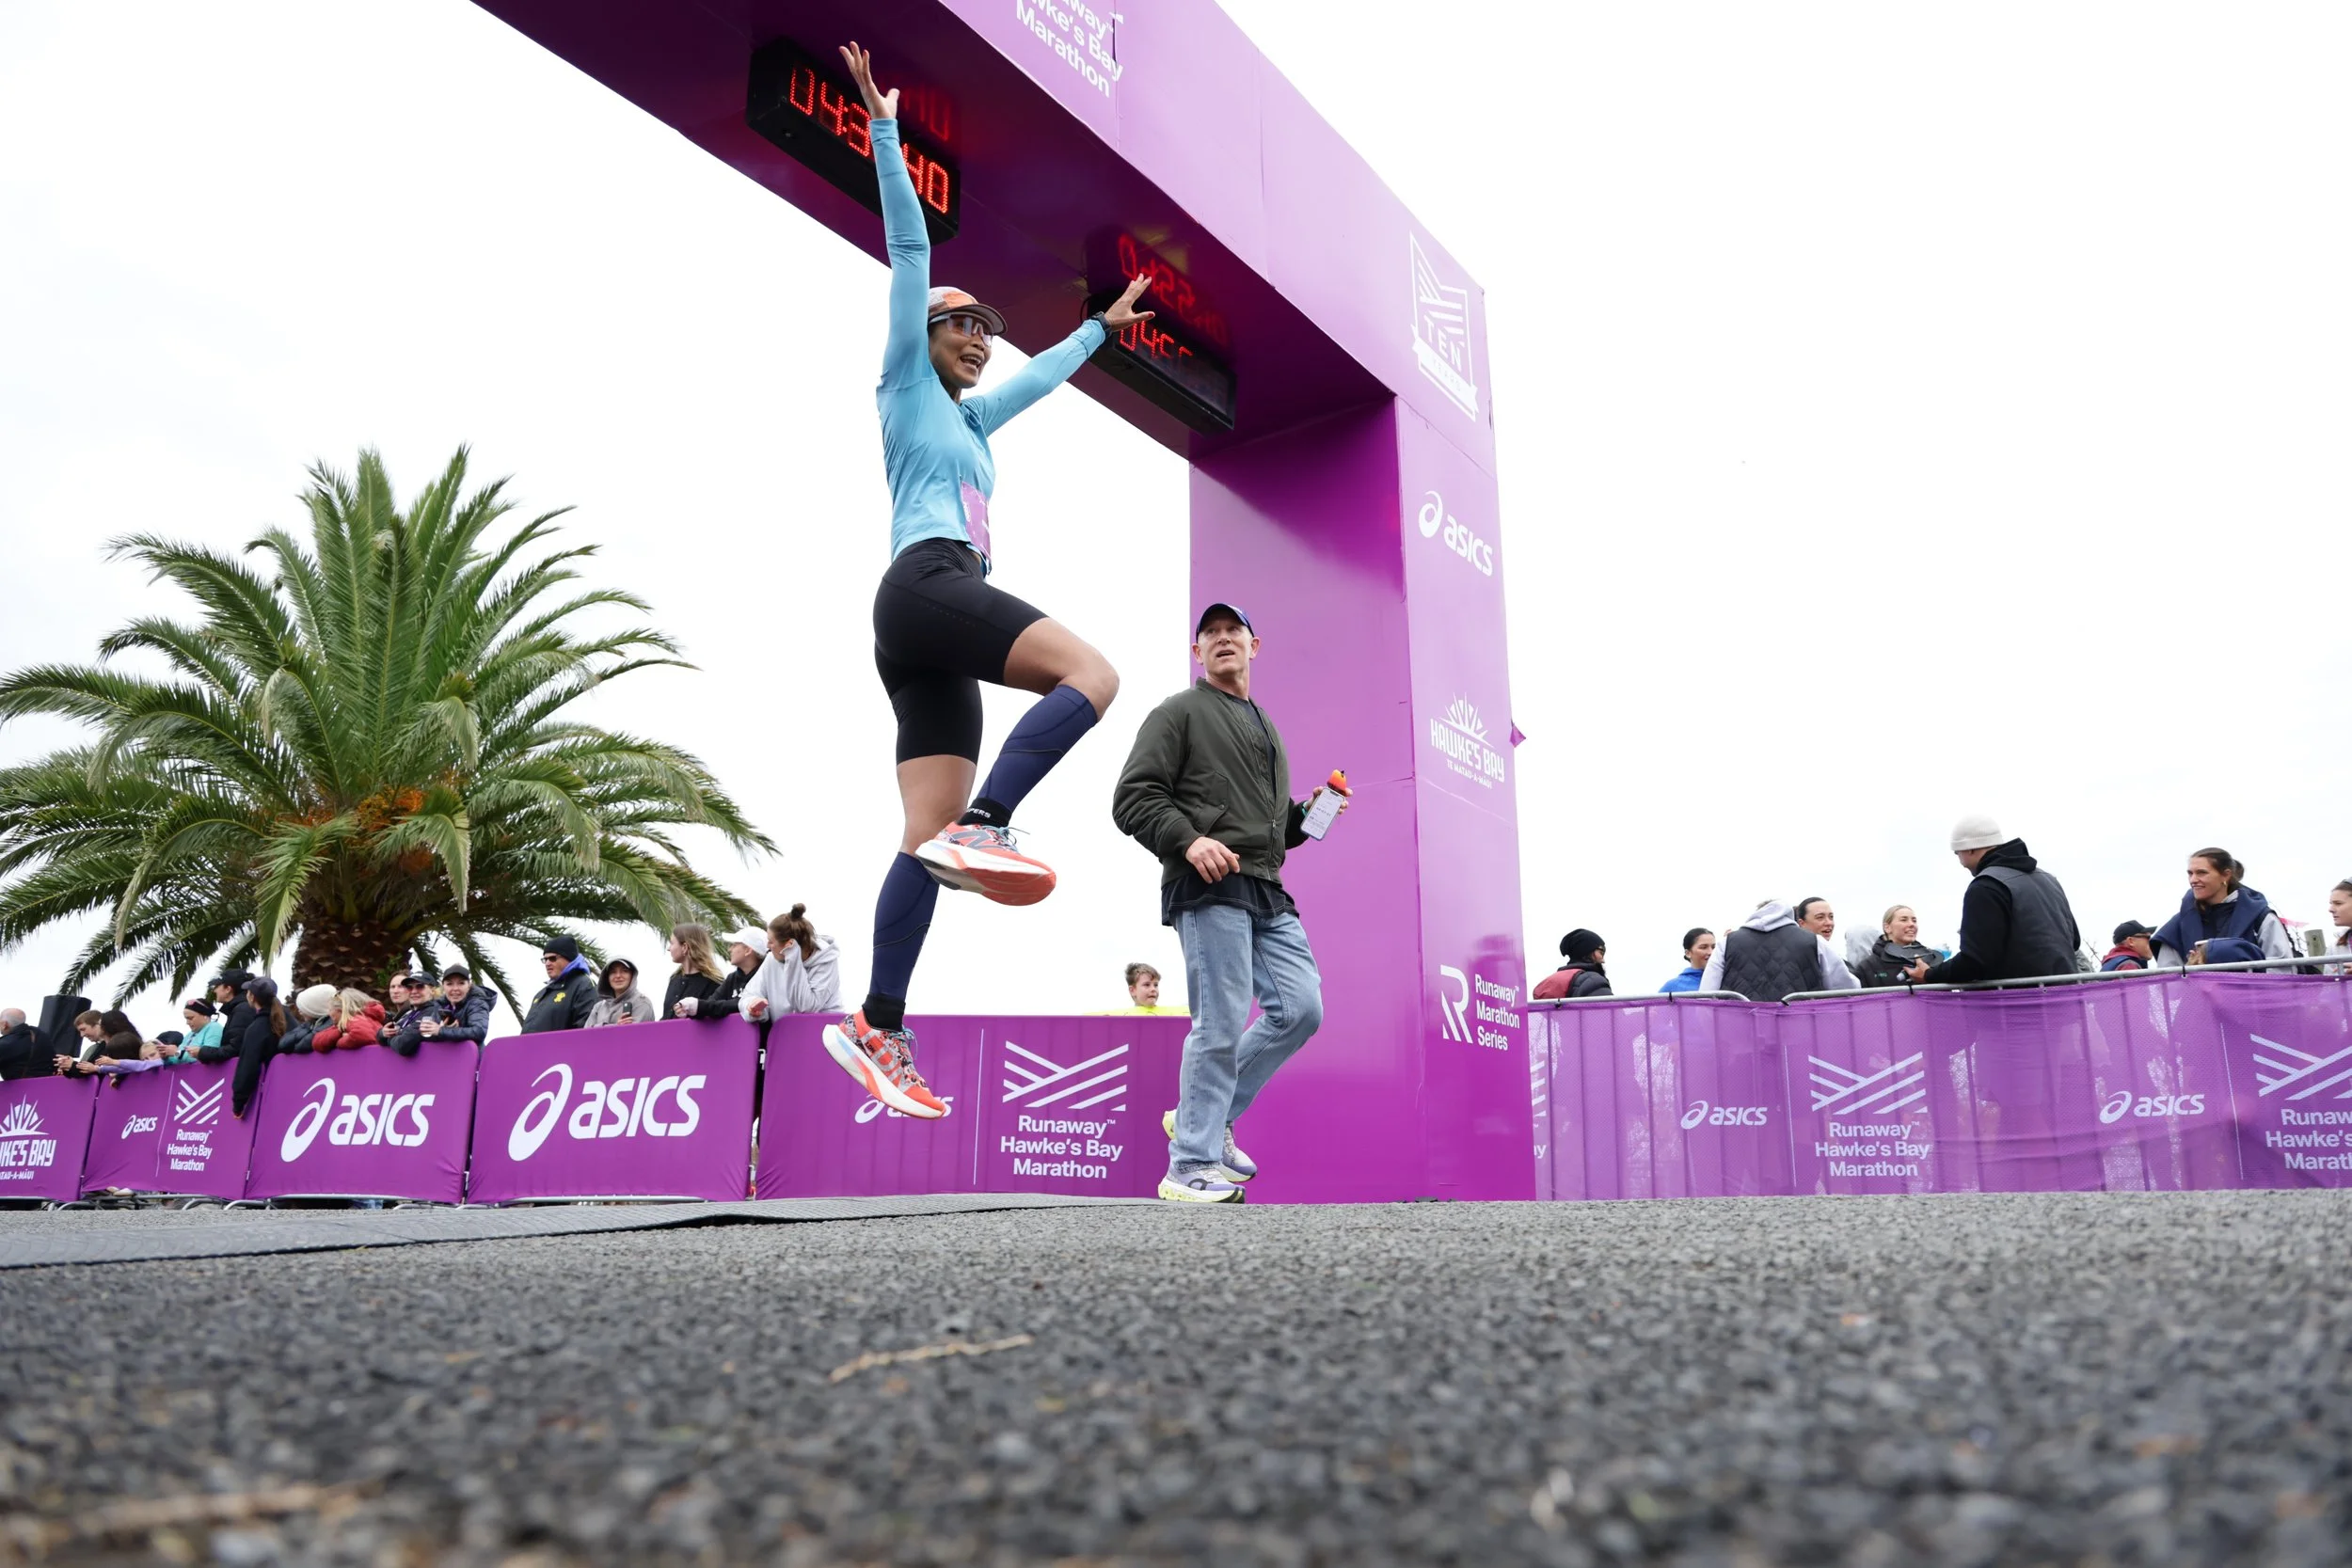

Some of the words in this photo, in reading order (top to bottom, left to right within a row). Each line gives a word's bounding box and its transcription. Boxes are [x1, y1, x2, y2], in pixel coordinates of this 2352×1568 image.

[1016, 0, 1109, 98] Marathon
[1089, 32, 1124, 82] Bay
[1423, 314, 1465, 373] TEN
[1430, 718, 1482, 770] HAWKE'S
[1483, 748, 1505, 784] BAY
[1476, 1000, 1520, 1029] Marathon
[1477, 1025, 1508, 1051] Series
[167, 1143, 199, 1156] Hawke's
[198, 1144, 213, 1160] Bay
[1000, 1136, 1082, 1156] Hawke's
[1086, 1139, 1123, 1162] Bay
[1815, 1141, 1892, 1157] Hawke's
[1894, 1141, 1931, 1160] Bay
[2265, 1130, 2352, 1148] Hawke's
[27, 1139, 56, 1166] BAY
[170, 1158, 205, 1172] Marathon
[1013, 1158, 1106, 1179] Marathon
[1829, 1161, 1918, 1177] Marathon
